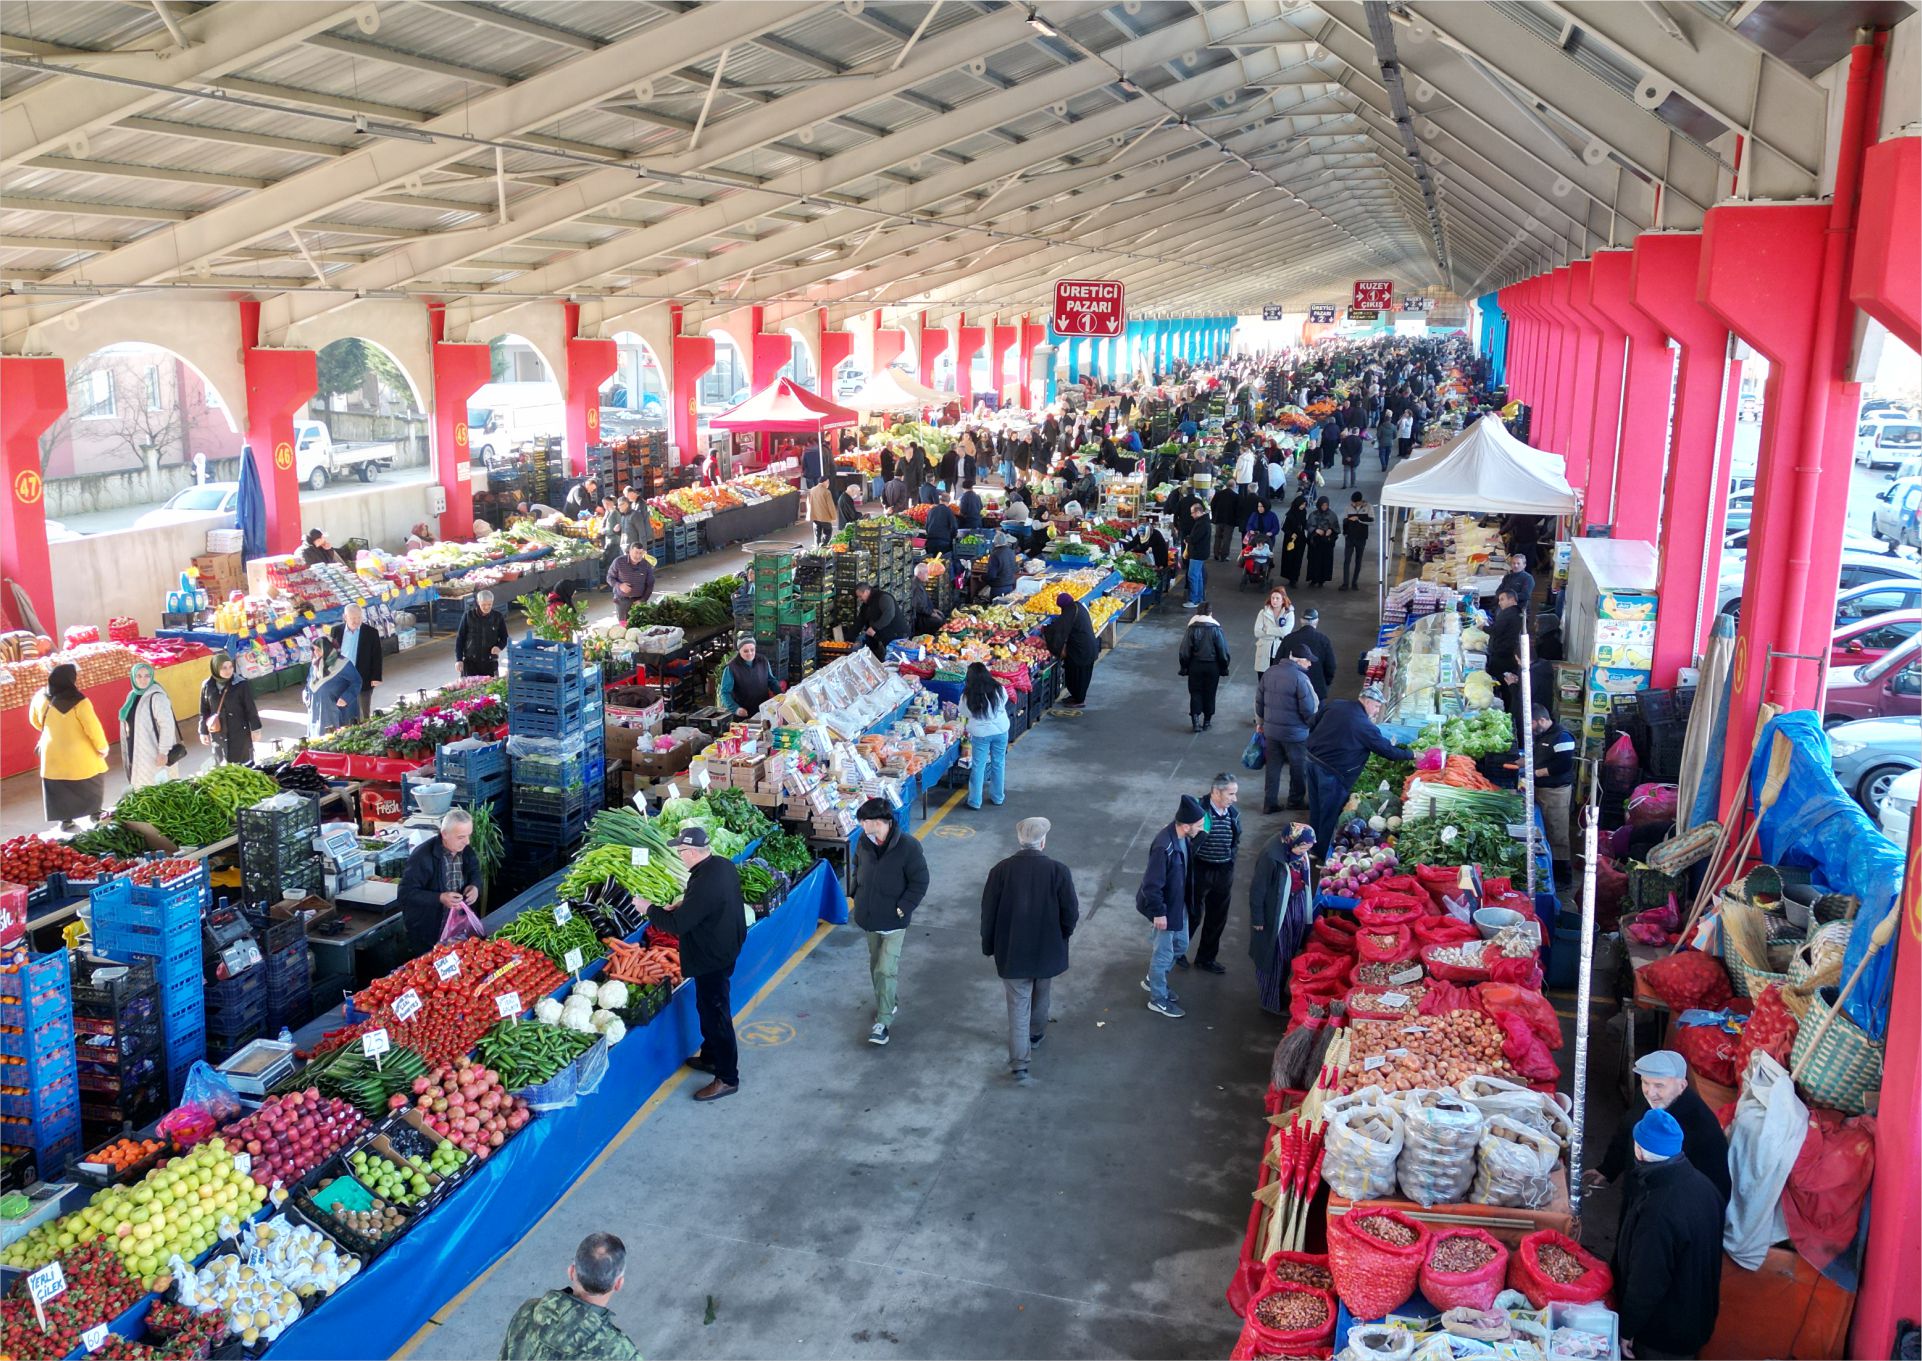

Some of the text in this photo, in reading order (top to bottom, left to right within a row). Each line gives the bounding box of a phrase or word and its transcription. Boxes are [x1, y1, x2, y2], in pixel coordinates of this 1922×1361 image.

[1060, 283, 1119, 299] ÜRETİCİ
[1360, 282, 1389, 290] KUZEY
[1369, 290, 1376, 301] 1
[1066, 300, 1112, 313] PAZARI
[1361, 301, 1384, 310] ÇIKIŞ
[1081, 314, 1091, 332] 1
[278, 448, 291, 465] 46
[20, 476, 37, 497] 47
[365, 1031, 384, 1053] 25
[30, 1266, 55, 1291] YERLİ
[37, 1279, 64, 1303] ÇİLEK
[87, 1331, 100, 1348] 60
